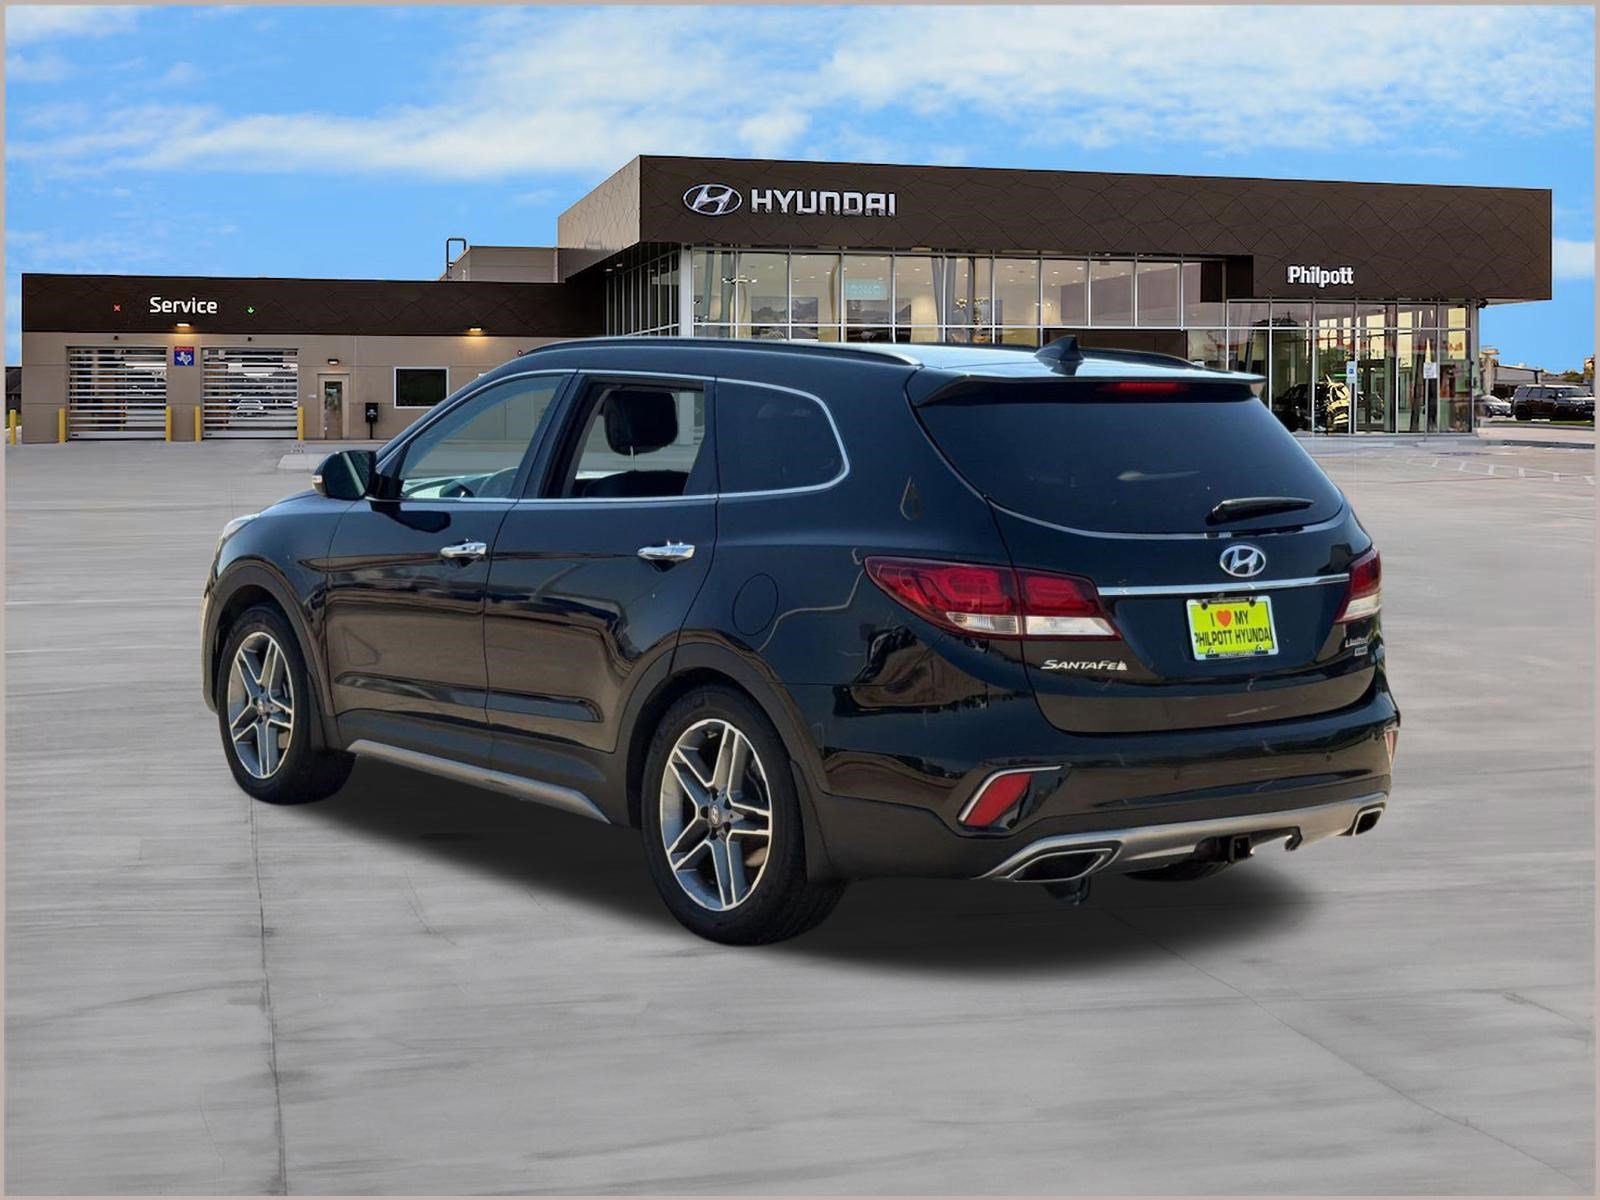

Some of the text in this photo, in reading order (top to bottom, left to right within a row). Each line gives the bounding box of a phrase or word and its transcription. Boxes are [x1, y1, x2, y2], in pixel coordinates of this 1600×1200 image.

[751, 189, 896, 216] HYUNDAI
[1287, 266, 1354, 288] Philpott
[149, 296, 218, 314] Service
[1210, 610, 1249, 627] I MY
